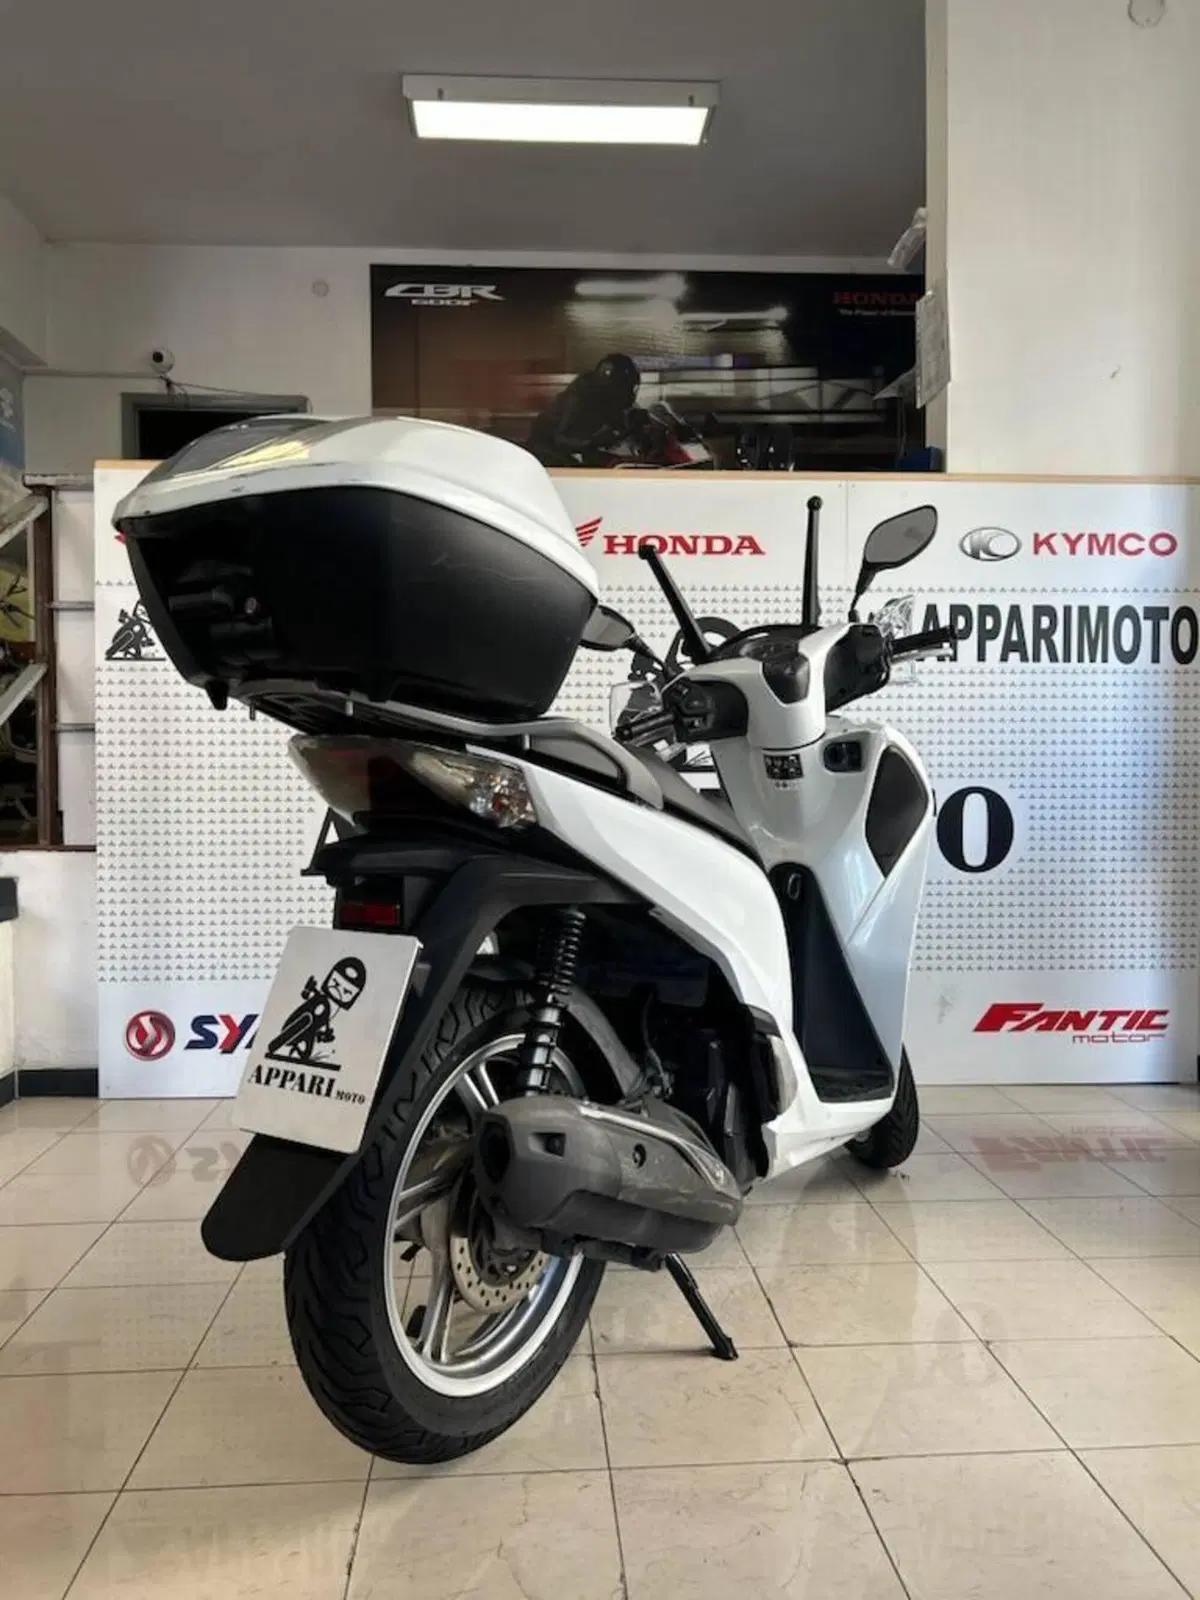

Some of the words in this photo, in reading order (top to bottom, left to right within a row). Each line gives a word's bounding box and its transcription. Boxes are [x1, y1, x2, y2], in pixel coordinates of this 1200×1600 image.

[385, 283, 506, 300] CBR
[603, 534, 766, 556] HONDA
[1032, 531, 1178, 557] KYMCO
[915, 604, 1199, 665] APPARIMOTO
[972, 1003, 1170, 1032] FANTIC
[183, 1013, 260, 1055] SY
[1072, 1032, 1166, 1044] motor
[247, 1064, 338, 1099] APPARI
[335, 1089, 367, 1105] MOTO
